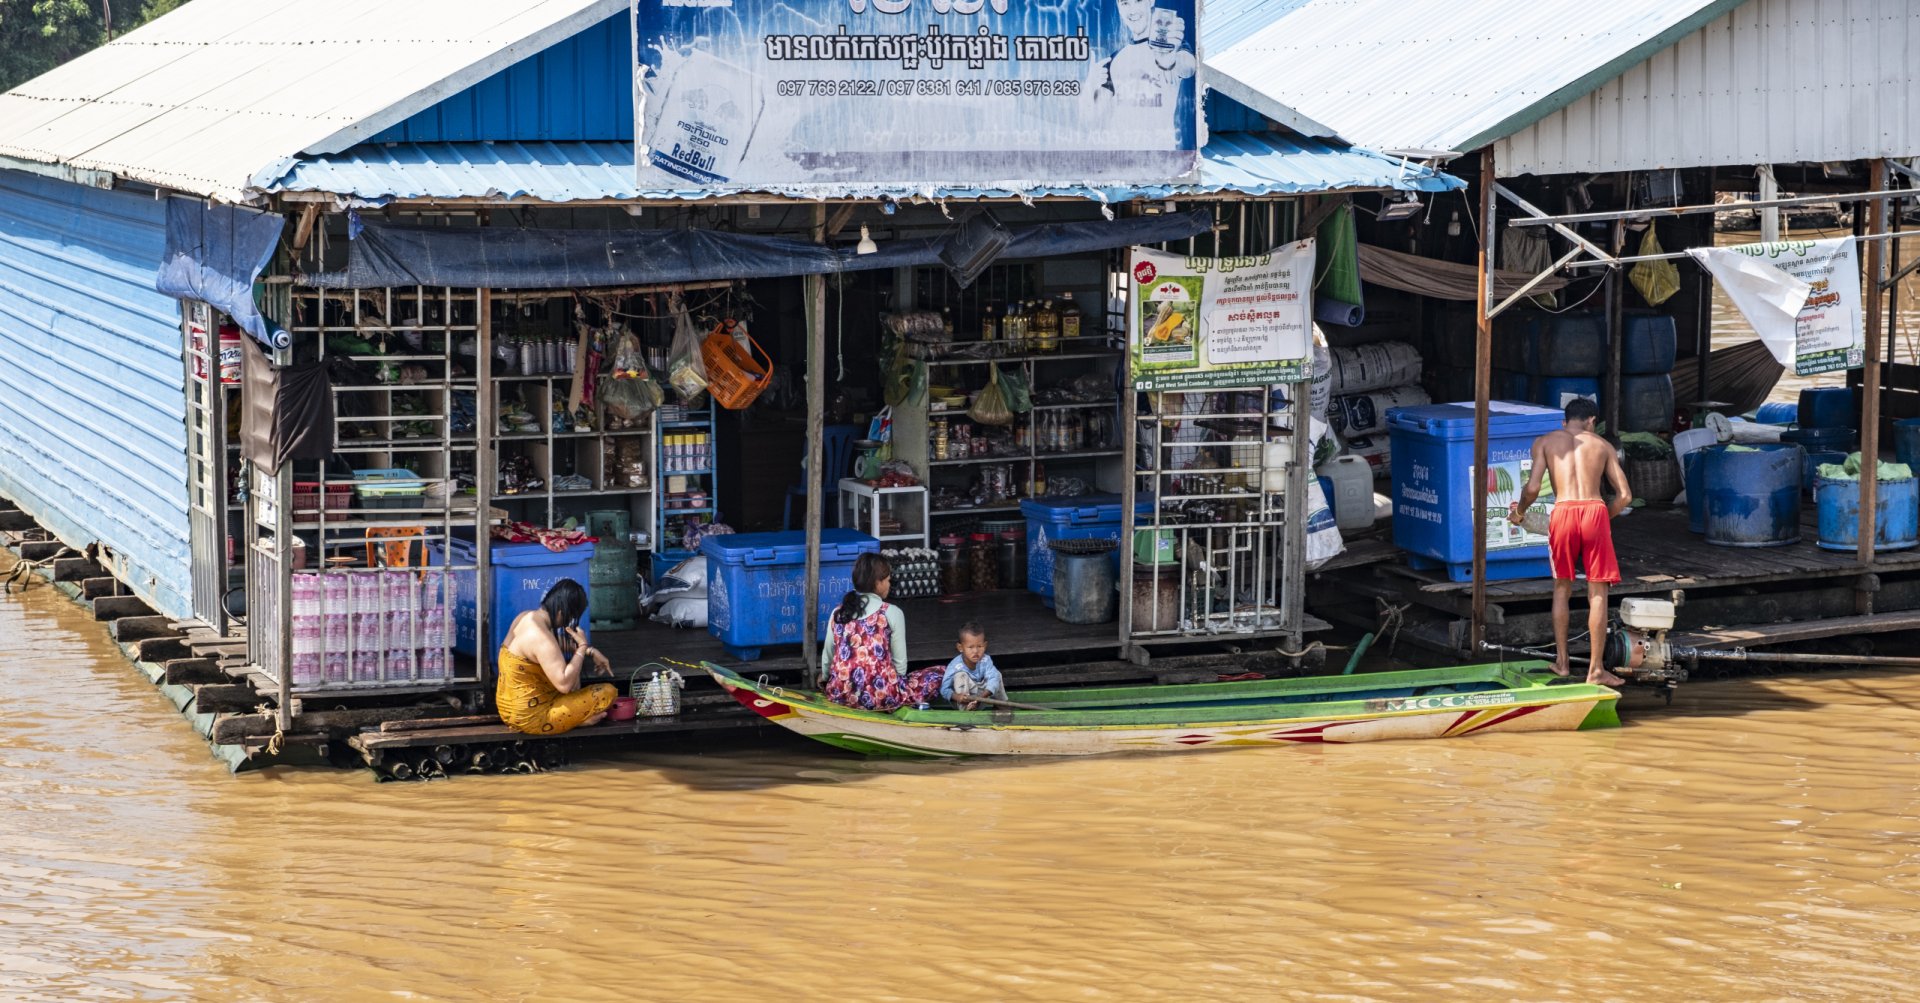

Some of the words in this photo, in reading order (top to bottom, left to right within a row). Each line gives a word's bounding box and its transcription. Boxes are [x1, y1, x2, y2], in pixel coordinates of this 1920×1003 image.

[777, 80, 806, 95] 097
[808, 80, 837, 95] 766
[838, 80, 876, 95] 2122
[877, 80, 885, 95] /
[886, 80, 914, 95] 097
[916, 80, 951, 95] 8381
[955, 80, 981, 95] 641
[984, 80, 993, 95] /
[993, 80, 1022, 95] 085
[1024, 80, 1051, 95] 976
[1053, 80, 1081, 96] 263
[689, 134, 711, 148] 250
[671, 142, 717, 172] RedBull
